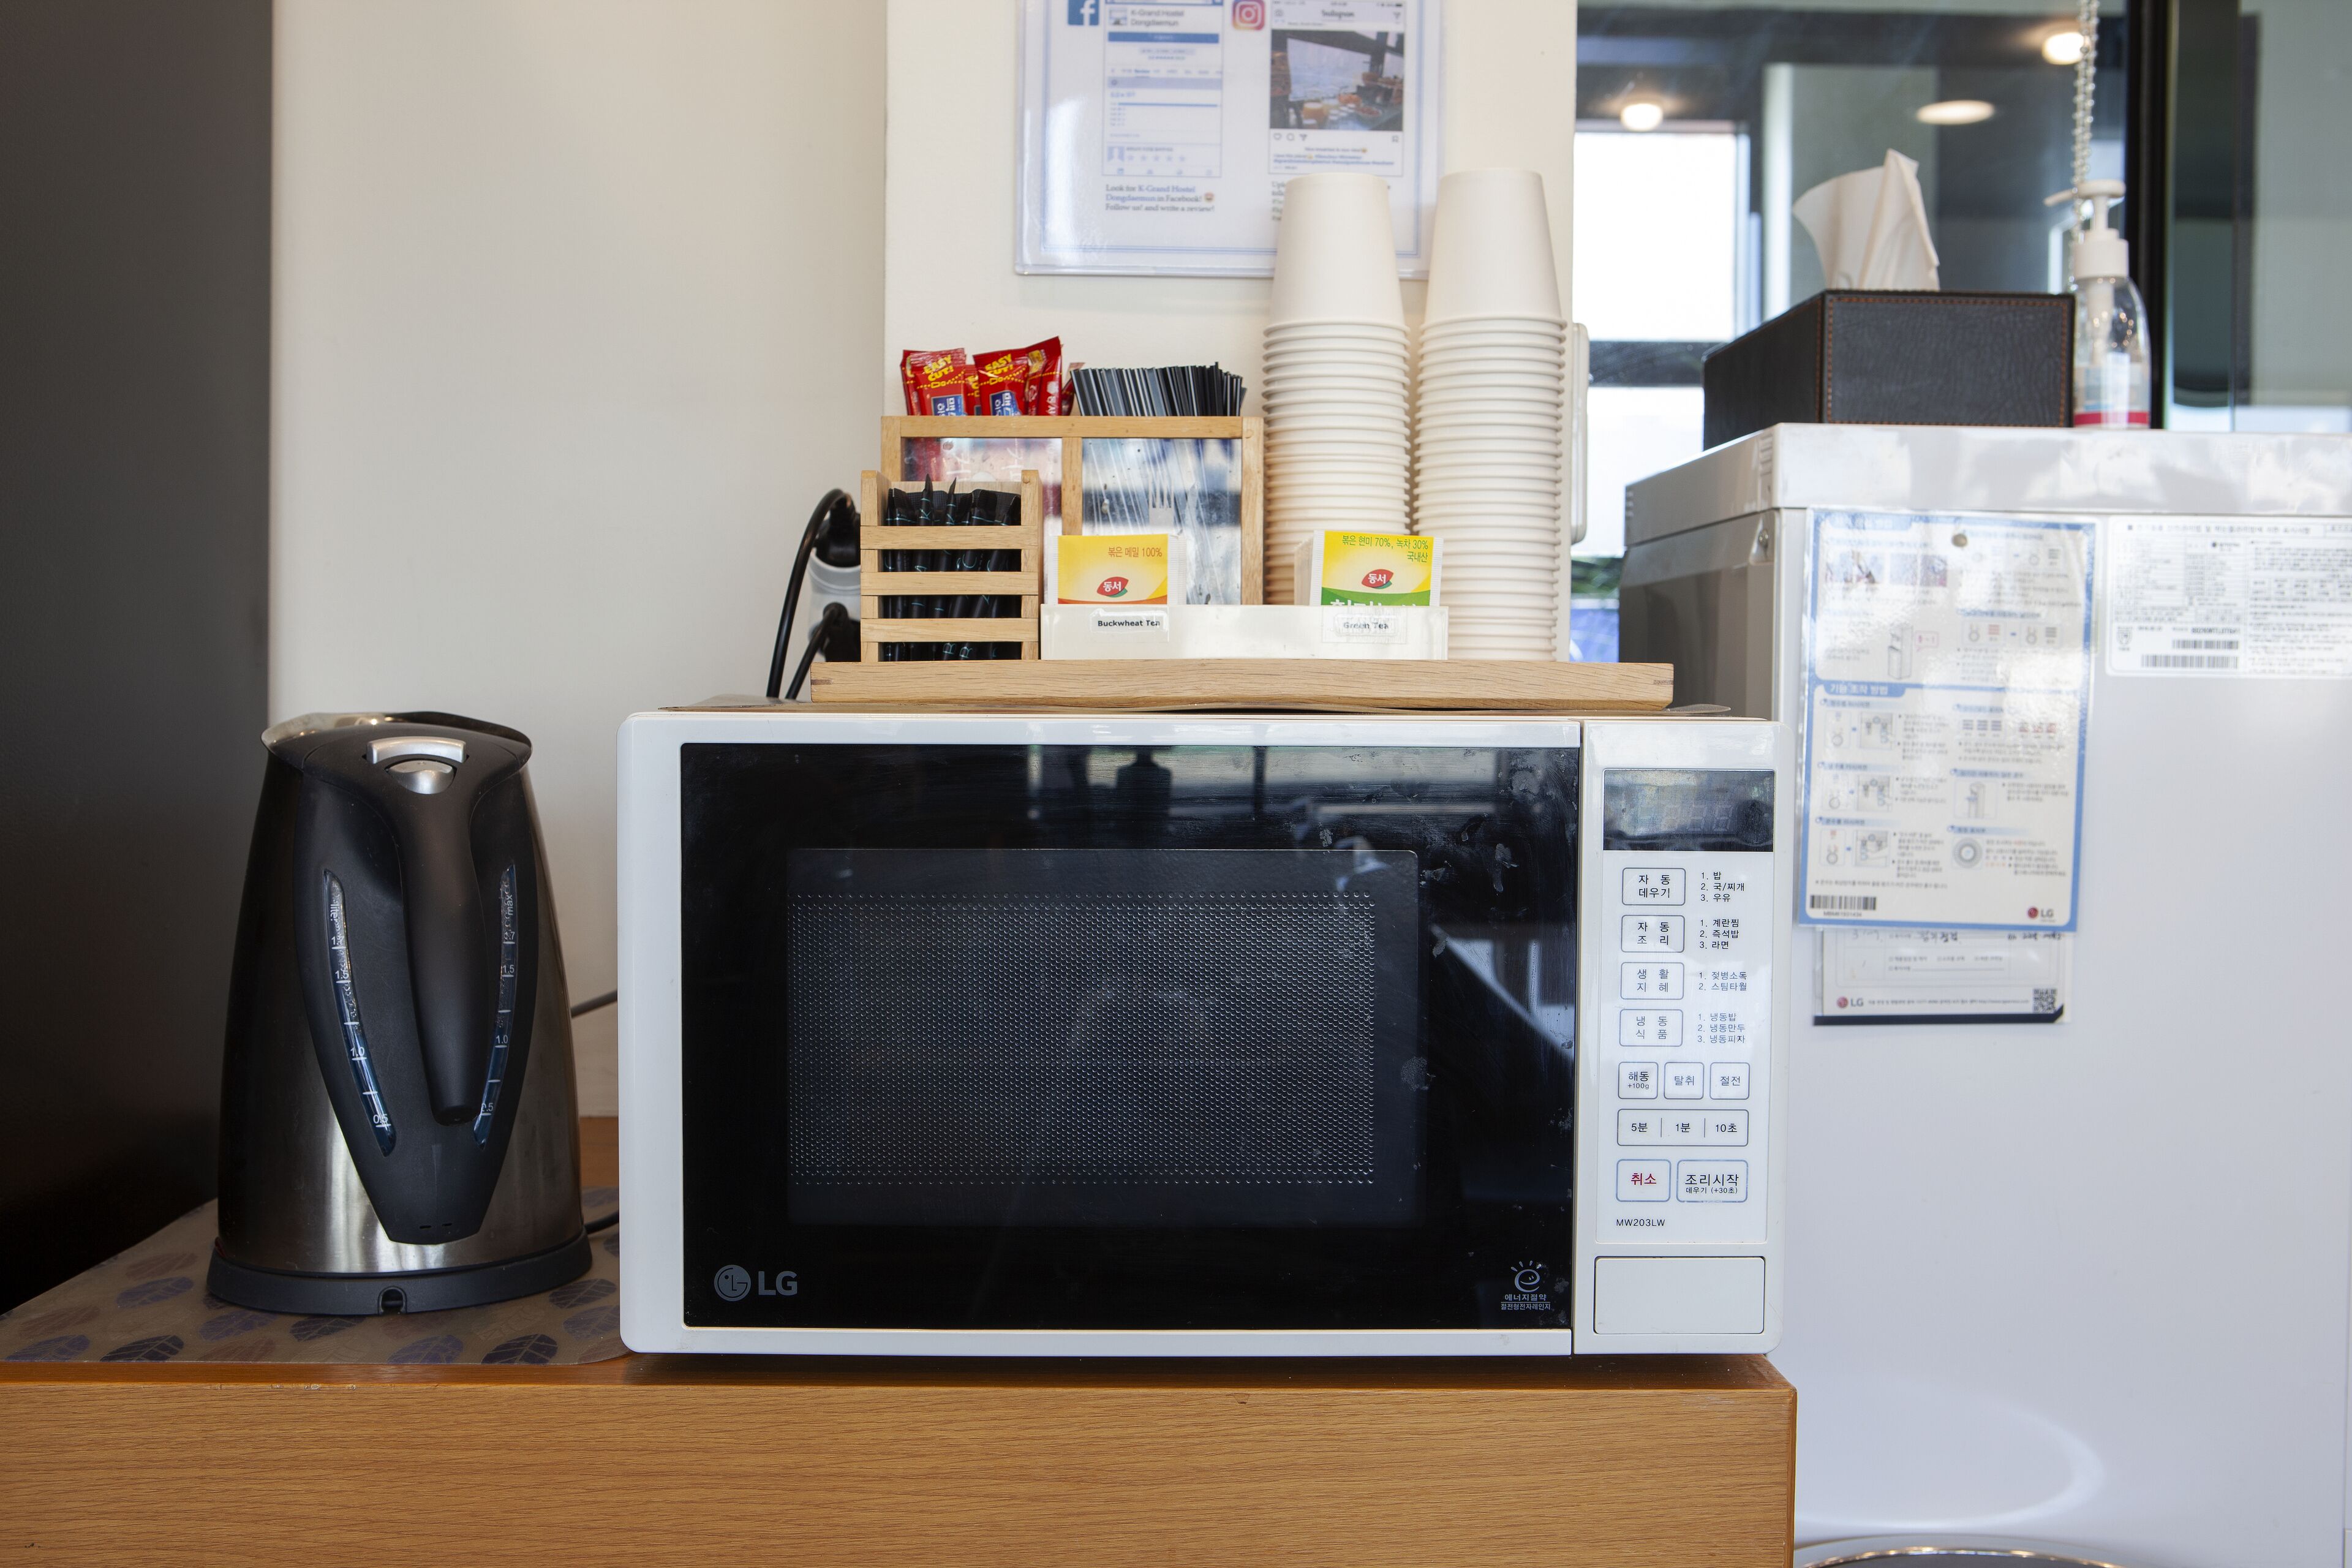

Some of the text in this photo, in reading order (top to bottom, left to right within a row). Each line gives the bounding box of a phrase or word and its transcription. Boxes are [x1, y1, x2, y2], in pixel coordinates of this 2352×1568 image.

[923, 355, 952, 374] EASY
[985, 353, 1012, 370] EASY
[927, 366, 954, 381] CUT!
[1342, 535, 1428, 550] 볶은 현미 70%, 녹차 30%
[1108, 546, 1163, 558] 볶은 메밀 100%
[1407, 551, 1428, 563] 국내산
[1368, 573, 1387, 584] 동서
[1103, 581, 1121, 592] 동서
[1713, 871, 1722, 880] 밥
[1713, 882, 1745, 892] 국/찌개
[1638, 888, 1671, 899] 데우기
[1713, 893, 1731, 902] 우유
[2040, 908, 2054, 918] LG
[1713, 919, 1739, 927] 계란찜
[1712, 929, 1740, 938] 즉석밥
[1711, 940, 1729, 949] 라면
[502, 965, 514, 973] 1.5
[335, 970, 349, 979] 1.5
[1711, 971, 1747, 980] 젖병소독
[1711, 982, 1747, 991] 스팀타월
[1850, 997, 1864, 1007] LG
[1710, 1013, 1736, 1022] 냉동밥
[1710, 1023, 1745, 1033] 냉동만두
[496, 1035, 508, 1044] 1.0
[1709, 1035, 1745, 1044] 냉동피자
[350, 1047, 365, 1057] 1.0
[1628, 1071, 1649, 1082] 해동
[1674, 1075, 1694, 1086] 탈취
[1720, 1076, 1741, 1086] 절전
[373, 1114, 388, 1124] 0.5
[1631, 1123, 1648, 1133] 5분
[1675, 1123, 1691, 1133] 1분
[1715, 1123, 1738, 1133] 10초
[1630, 1172, 1657, 1186] 취소
[1685, 1174, 1739, 1186] 조리시작
[758, 1270, 798, 1296] LG
